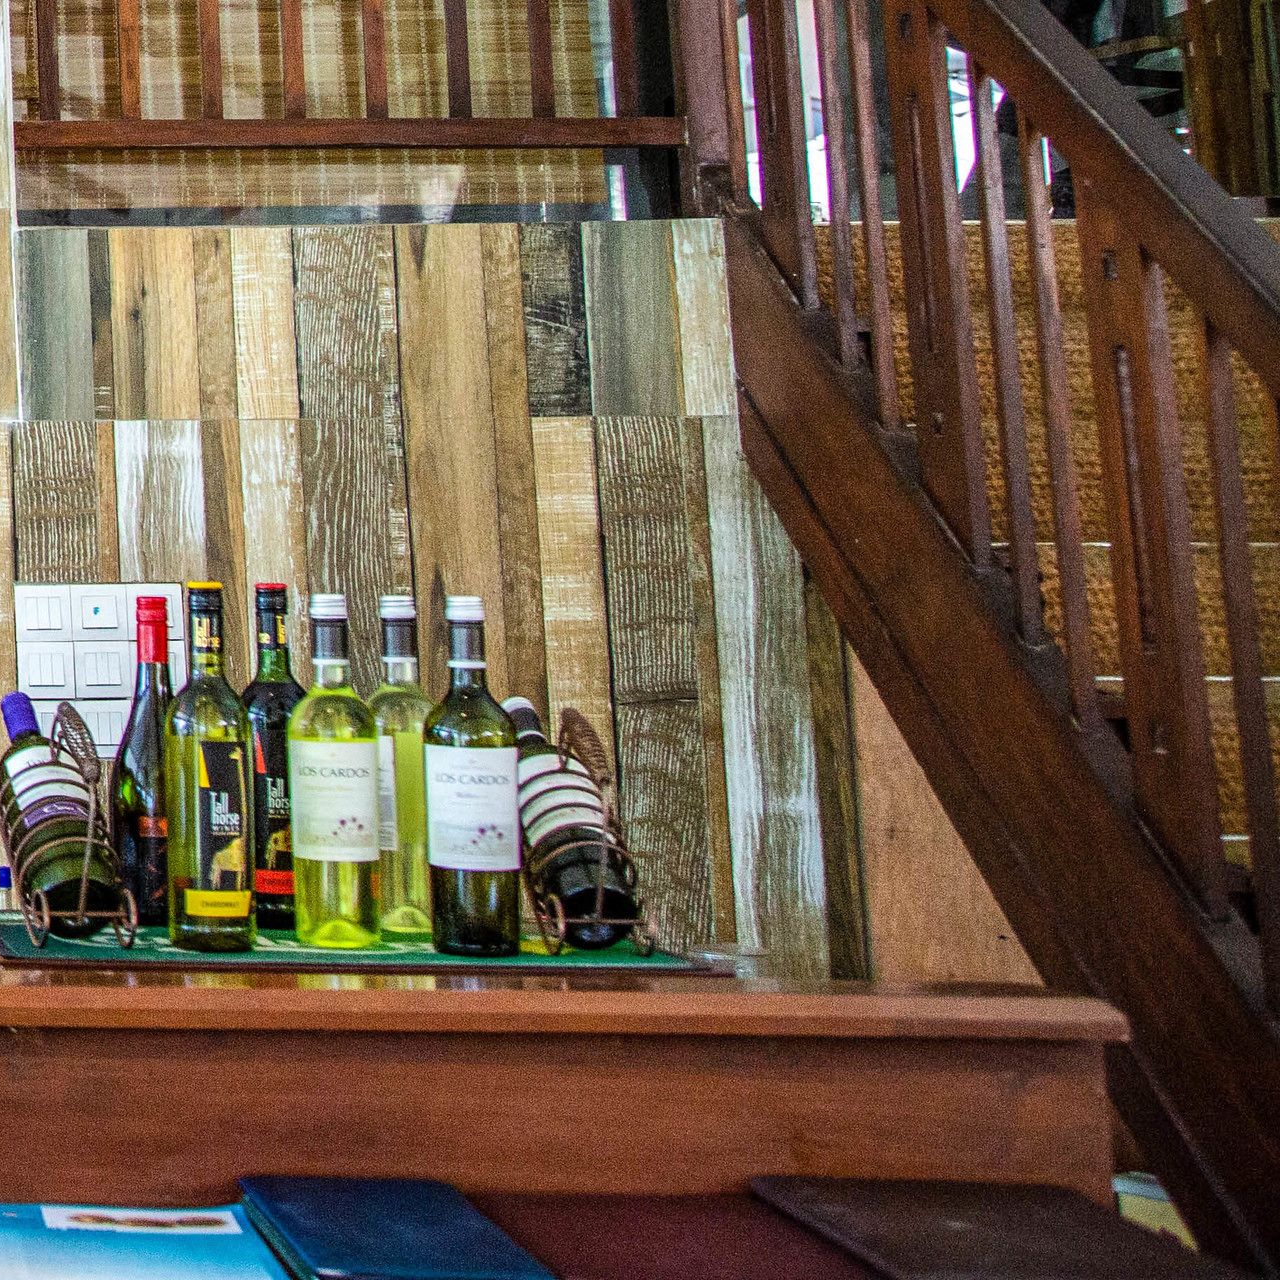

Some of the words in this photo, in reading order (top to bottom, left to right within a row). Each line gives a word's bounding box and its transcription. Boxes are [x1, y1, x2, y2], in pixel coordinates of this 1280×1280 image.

[299, 766, 318, 777] LOS
[319, 767, 371, 778] CARDOS
[435, 773, 457, 783] LOS
[459, 774, 509, 785] CARDOS
[266, 777, 285, 800] Tall
[209, 791, 229, 815] Tall
[268, 797, 291, 811] hors
[211, 812, 240, 826] horse
